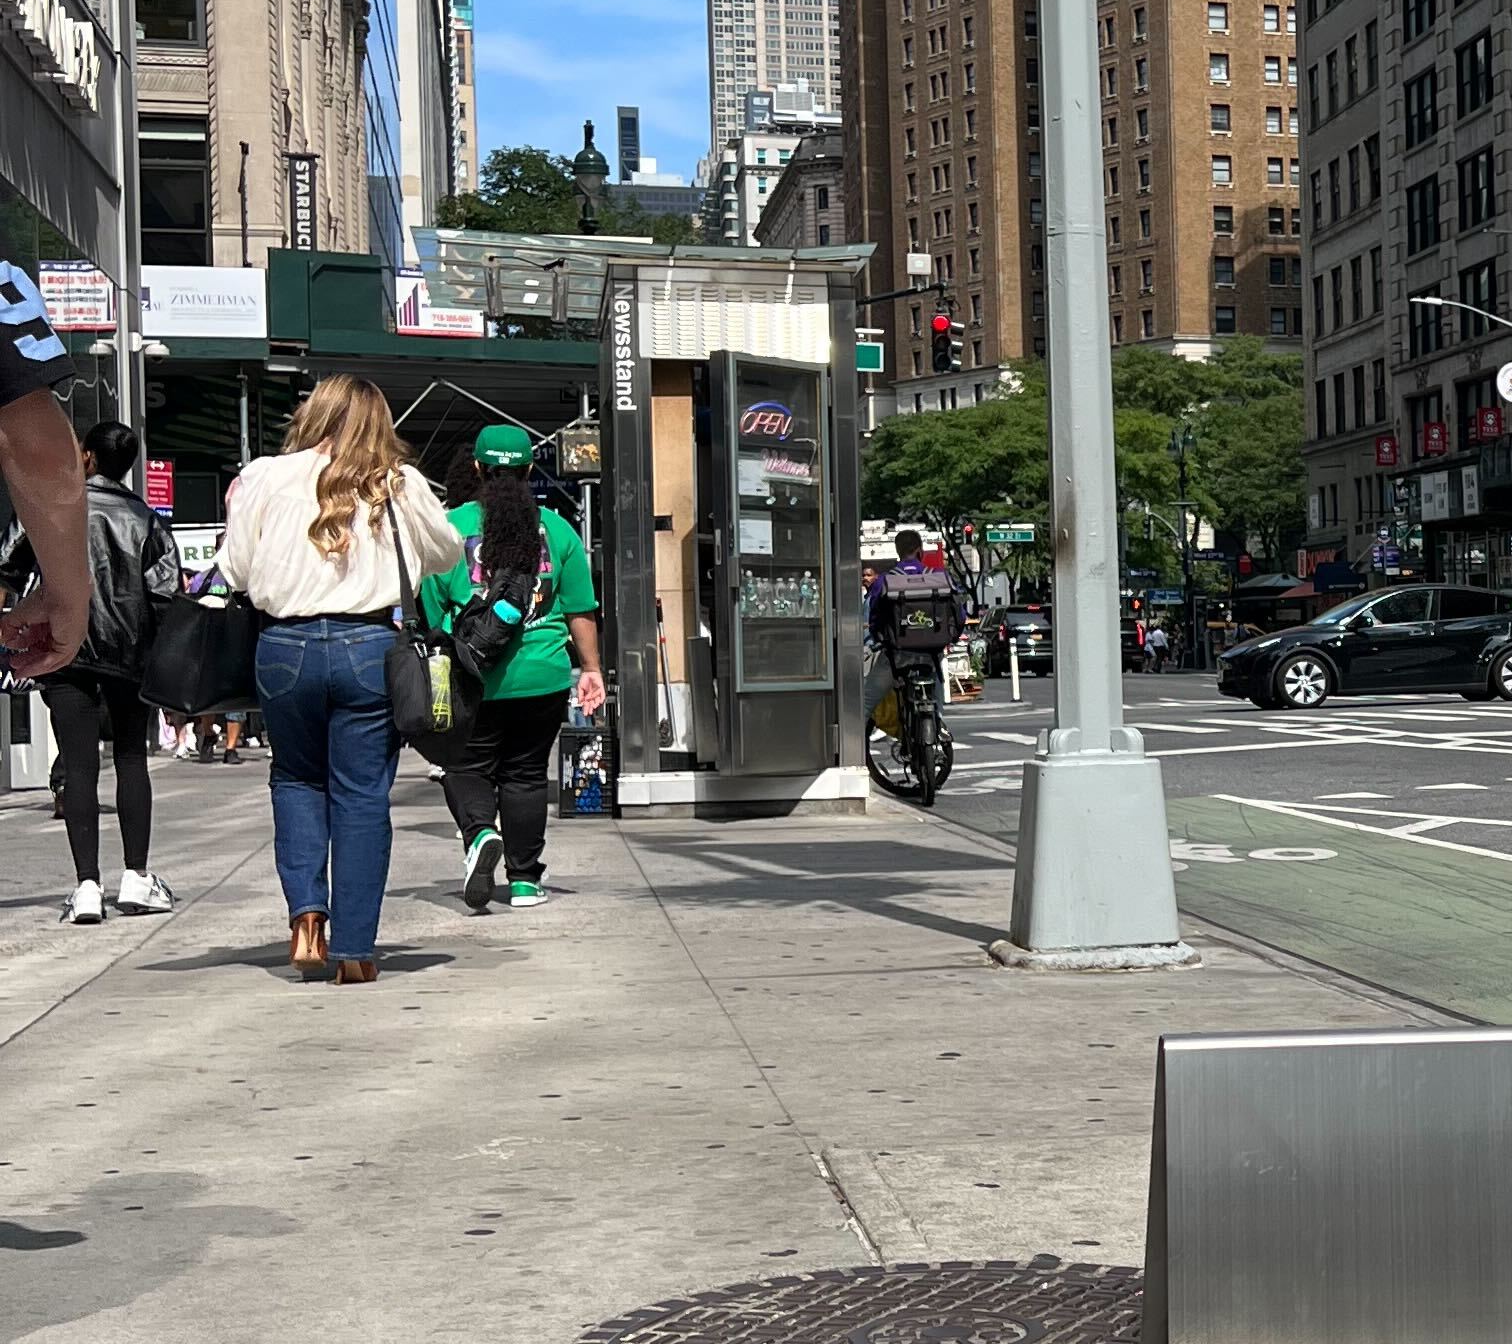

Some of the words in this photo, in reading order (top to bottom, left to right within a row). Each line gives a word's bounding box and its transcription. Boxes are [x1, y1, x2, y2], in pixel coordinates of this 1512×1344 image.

[170, 293, 257, 306] ZIMMERMAN
[614, 283, 638, 411] Newsstand
[740, 411, 793, 435] OPEN
